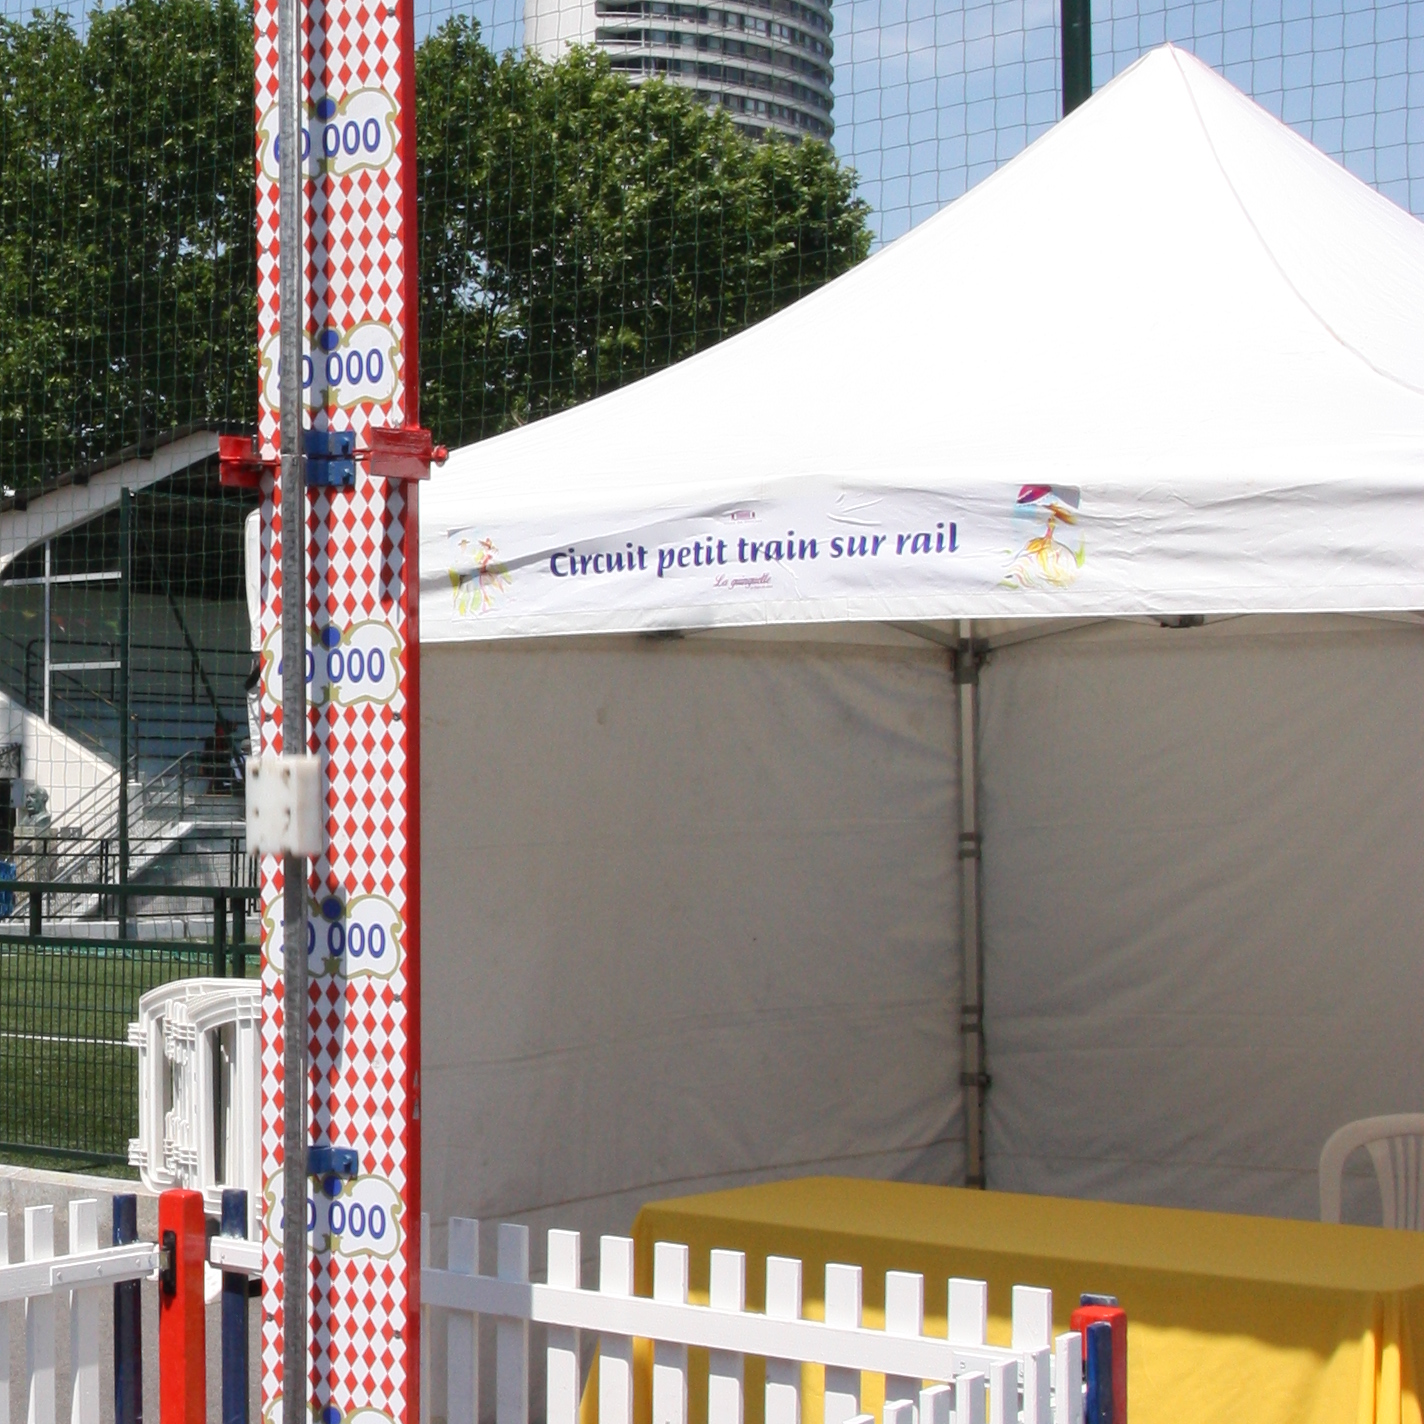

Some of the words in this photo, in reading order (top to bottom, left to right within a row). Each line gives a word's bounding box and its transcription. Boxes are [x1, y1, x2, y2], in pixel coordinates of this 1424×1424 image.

[550, 542, 648, 577] Circuit
[657, 535, 728, 578] petit
[737, 530, 820, 563] train
[829, 534, 887, 559] sur
[895, 522, 960, 556] rail
